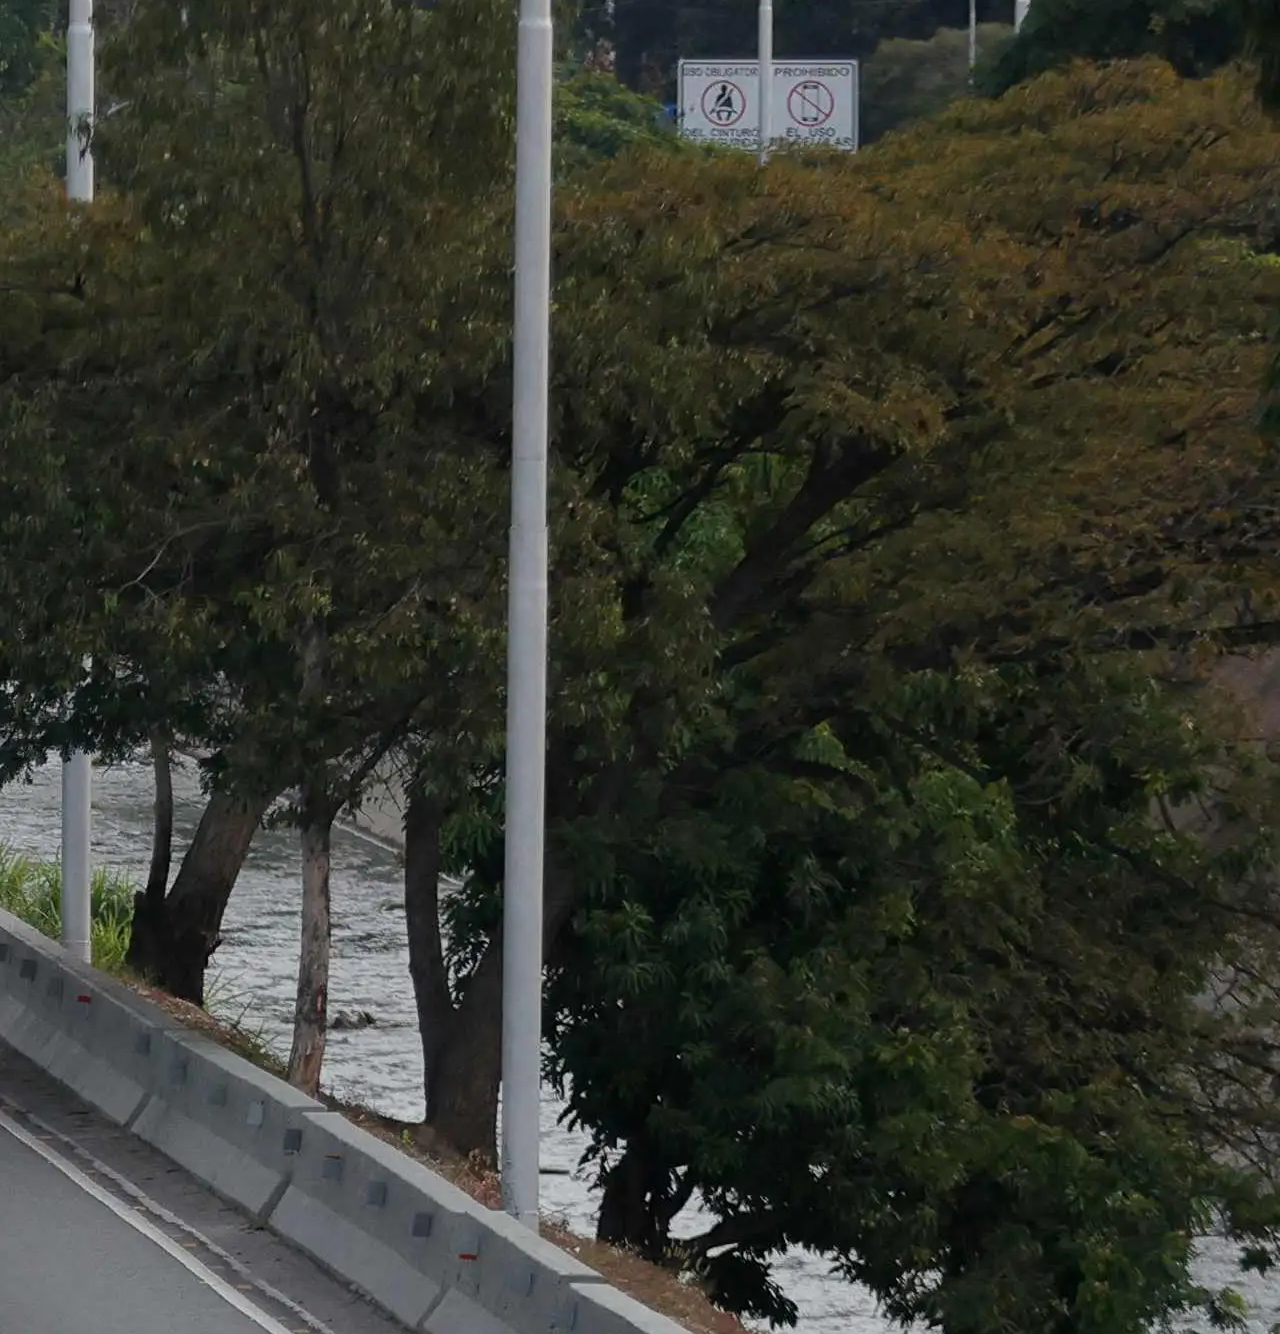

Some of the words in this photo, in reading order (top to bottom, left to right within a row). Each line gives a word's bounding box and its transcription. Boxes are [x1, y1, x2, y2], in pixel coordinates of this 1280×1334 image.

[705, 67, 759, 77] OBLIGATOR
[774, 67, 850, 77] PROHIBIDO
[786, 127, 800, 137] EL
[808, 127, 836, 137] USO
